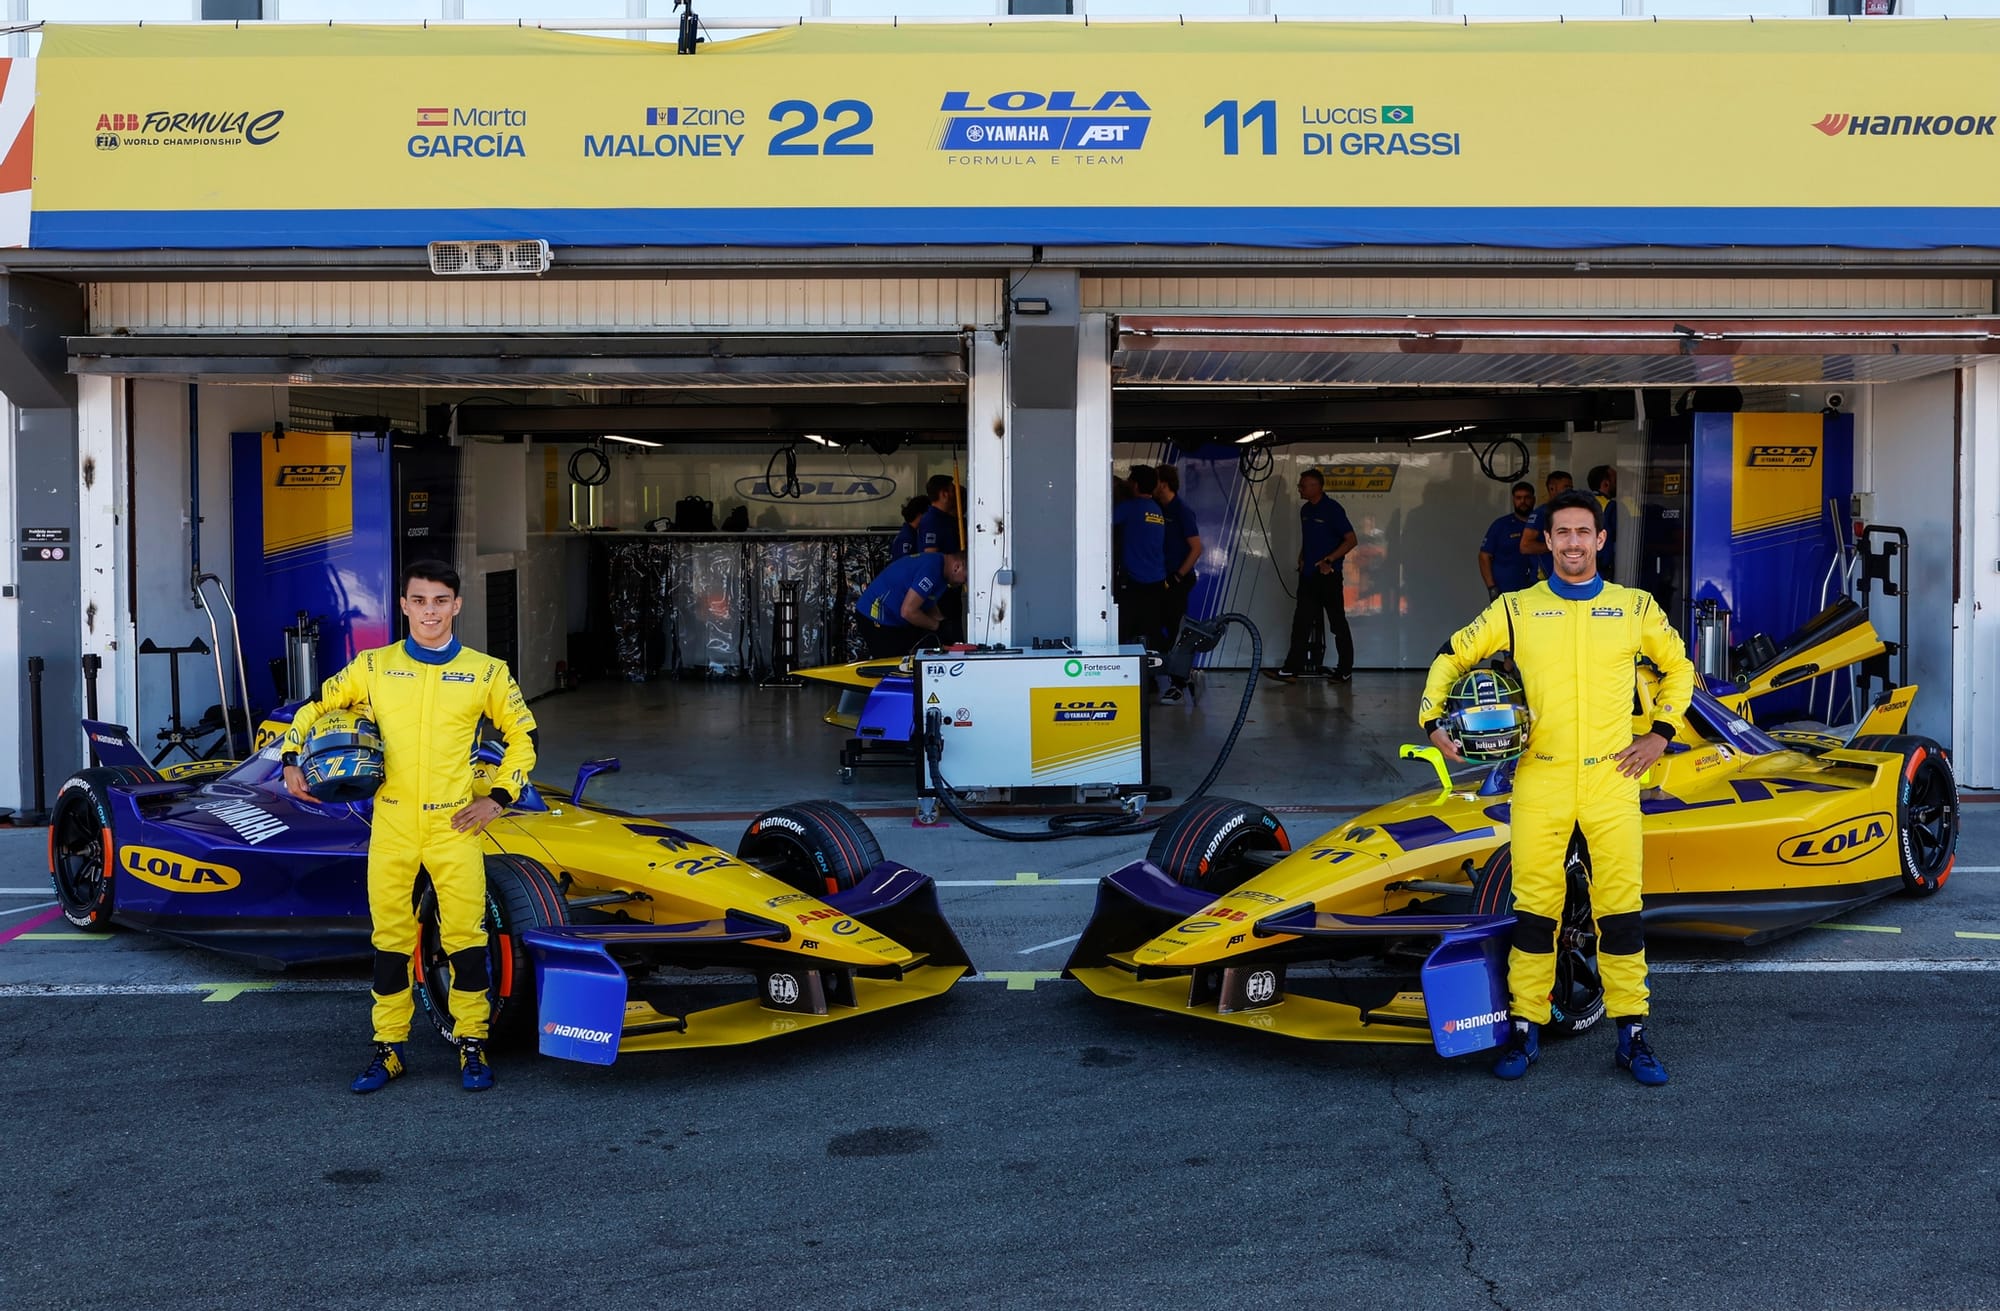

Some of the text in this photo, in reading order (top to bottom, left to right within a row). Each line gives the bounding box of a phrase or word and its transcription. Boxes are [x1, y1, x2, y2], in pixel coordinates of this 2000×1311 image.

[940, 91, 1152, 111] LOLA
[96, 113, 140, 131] ABB
[141, 111, 249, 134] FORMULA
[453, 107, 527, 127] Marta
[682, 107, 745, 126] Zane
[1302, 105, 1378, 125] Lucas
[767, 100, 874, 155] 22
[985, 125, 1130, 147] YAMAHA ABT
[1203, 100, 1278, 155] 11
[123, 138, 160, 146] WORLD
[163, 138, 242, 146] CHAMPIONSHIP
[407, 131, 526, 158] GARCÍA
[584, 134, 745, 157] MALONEY
[1303, 133, 1460, 155] DI GRASSI
[948, 155, 1124, 165] FORMULA E TEAM
[1753, 447, 1814, 455] LOLA
[283, 466, 343, 474] LOLA
[1084, 663, 1121, 671] Fortescue
[1054, 701, 1118, 709] LOLA
[1092, 711, 1109, 720] ABT
[1791, 821, 1886, 858] LOLA
[1310, 848, 1356, 864] 11
[128, 851, 229, 887] LOLA
[674, 856, 741, 876] 22
[796, 908, 844, 926] ABB
[1200, 907, 1248, 922] ABB
[800, 939, 820, 950] ABT
[1226, 933, 1247, 949] ABT
